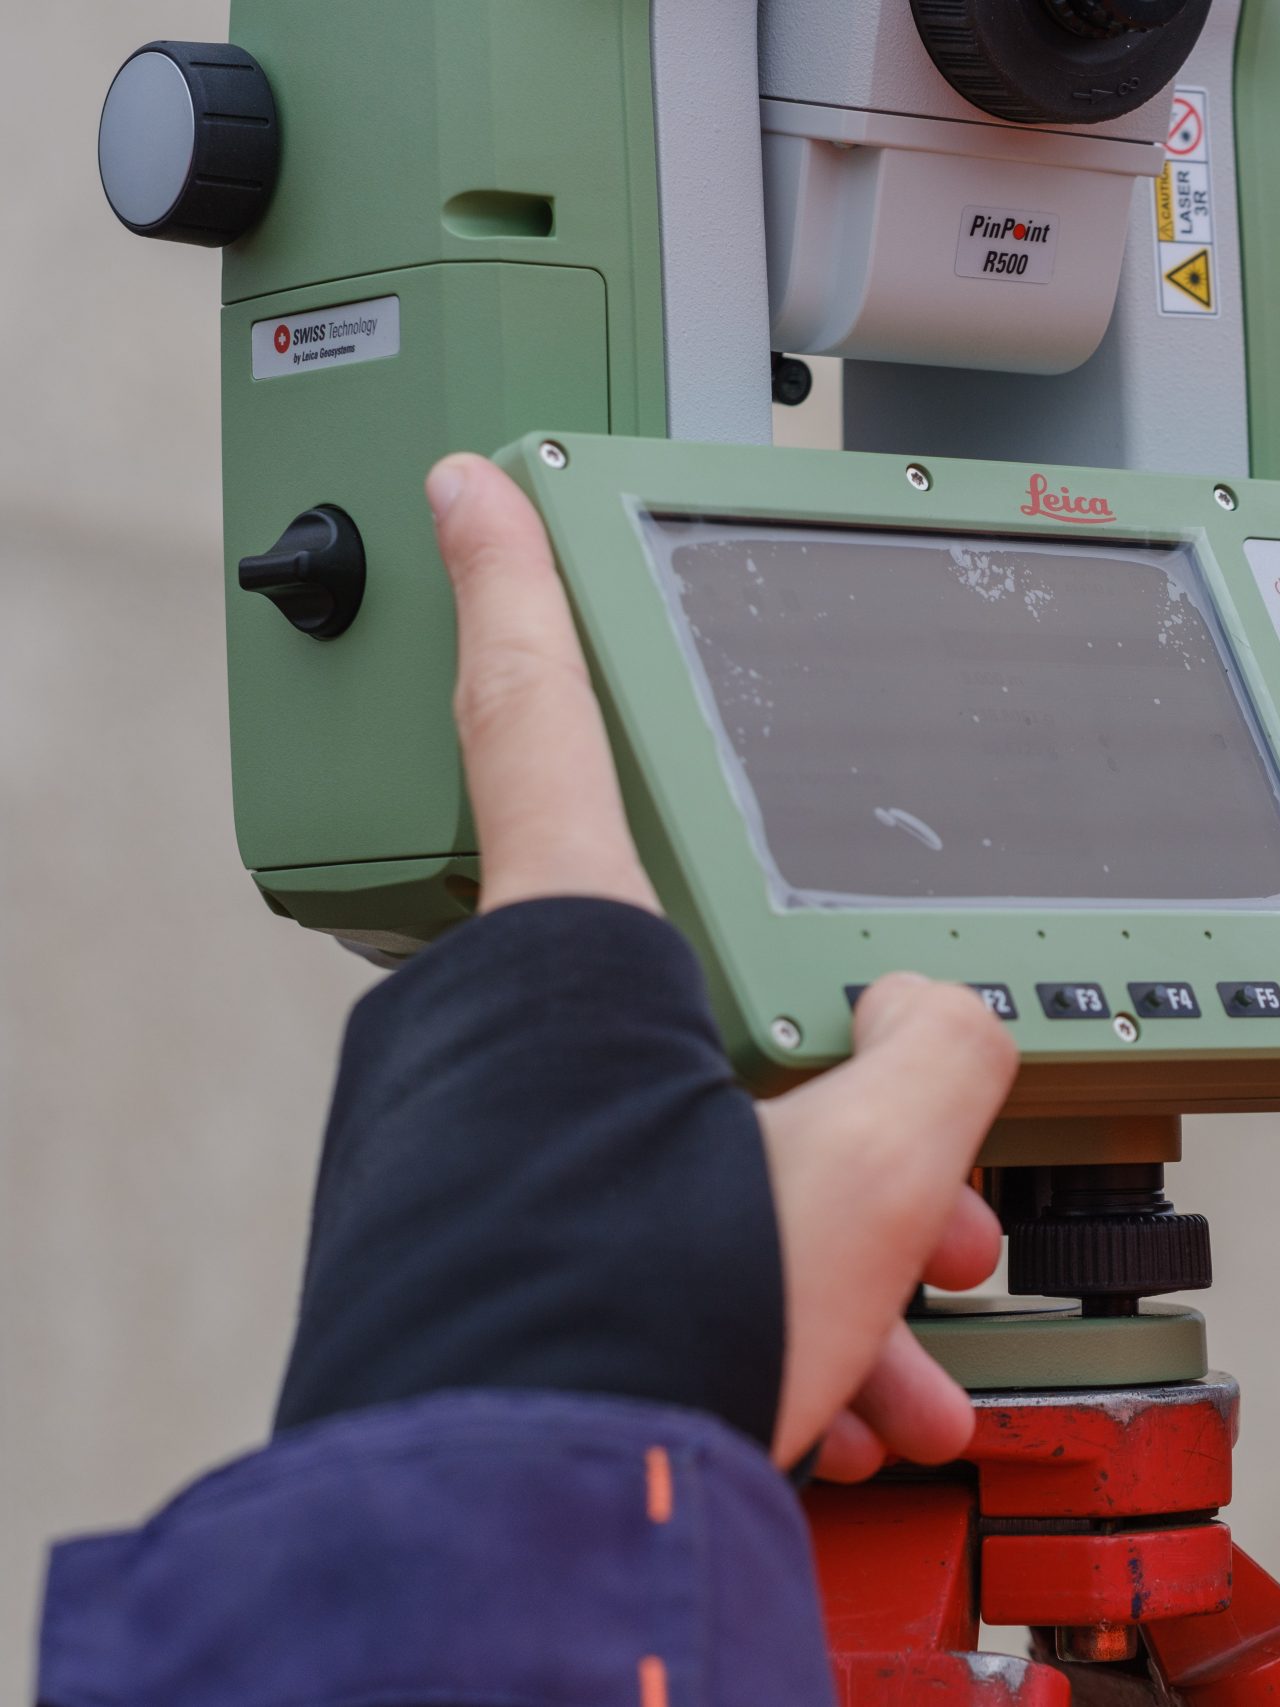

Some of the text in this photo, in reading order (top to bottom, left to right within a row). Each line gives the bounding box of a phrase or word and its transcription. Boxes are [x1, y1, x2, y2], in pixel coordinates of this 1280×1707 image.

[1177, 171, 1193, 234] LASER
[1193, 190, 1208, 217] 3R
[969, 214, 1050, 243] PinPoint
[982, 250, 1029, 275] R500
[293, 317, 378, 346] SWISS Technology
[293, 344, 355, 365] by Leica Geosystems
[1020, 473, 1117, 524] Leica
[981, 988, 1011, 1013] F2
[1075, 988, 1103, 1012] F3
[1166, 987, 1194, 1010] F4
[1254, 987, 1280, 1009] F5
